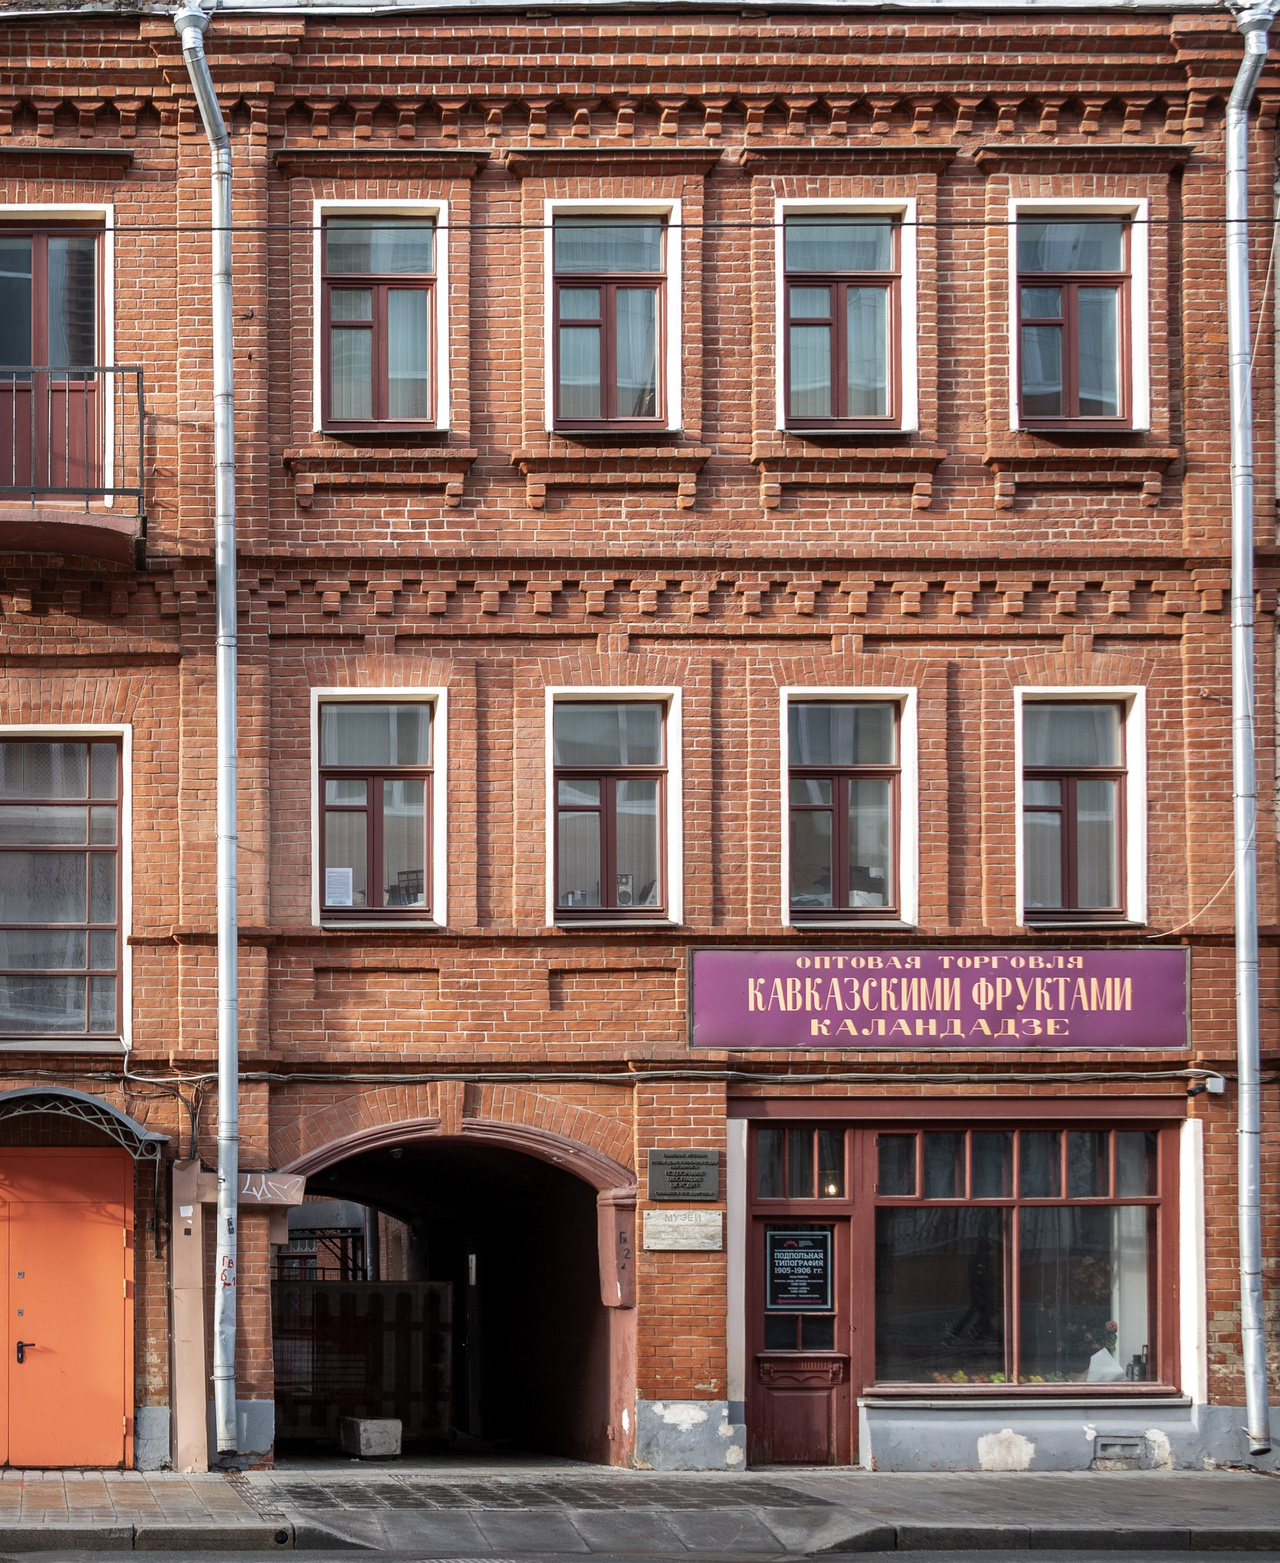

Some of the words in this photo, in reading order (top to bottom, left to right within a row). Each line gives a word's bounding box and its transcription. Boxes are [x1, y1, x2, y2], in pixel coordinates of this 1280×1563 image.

[796, 956, 922, 970] ОПТОВАЯ
[938, 955, 1084, 970] ТОРГОВЛЯ
[748, 977, 962, 1012] КАВКАЗСКИМИ
[971, 977, 1133, 1012] ФРУКТАМИ
[810, 1018, 1070, 1040] КАЛАНДАДЗЕ
